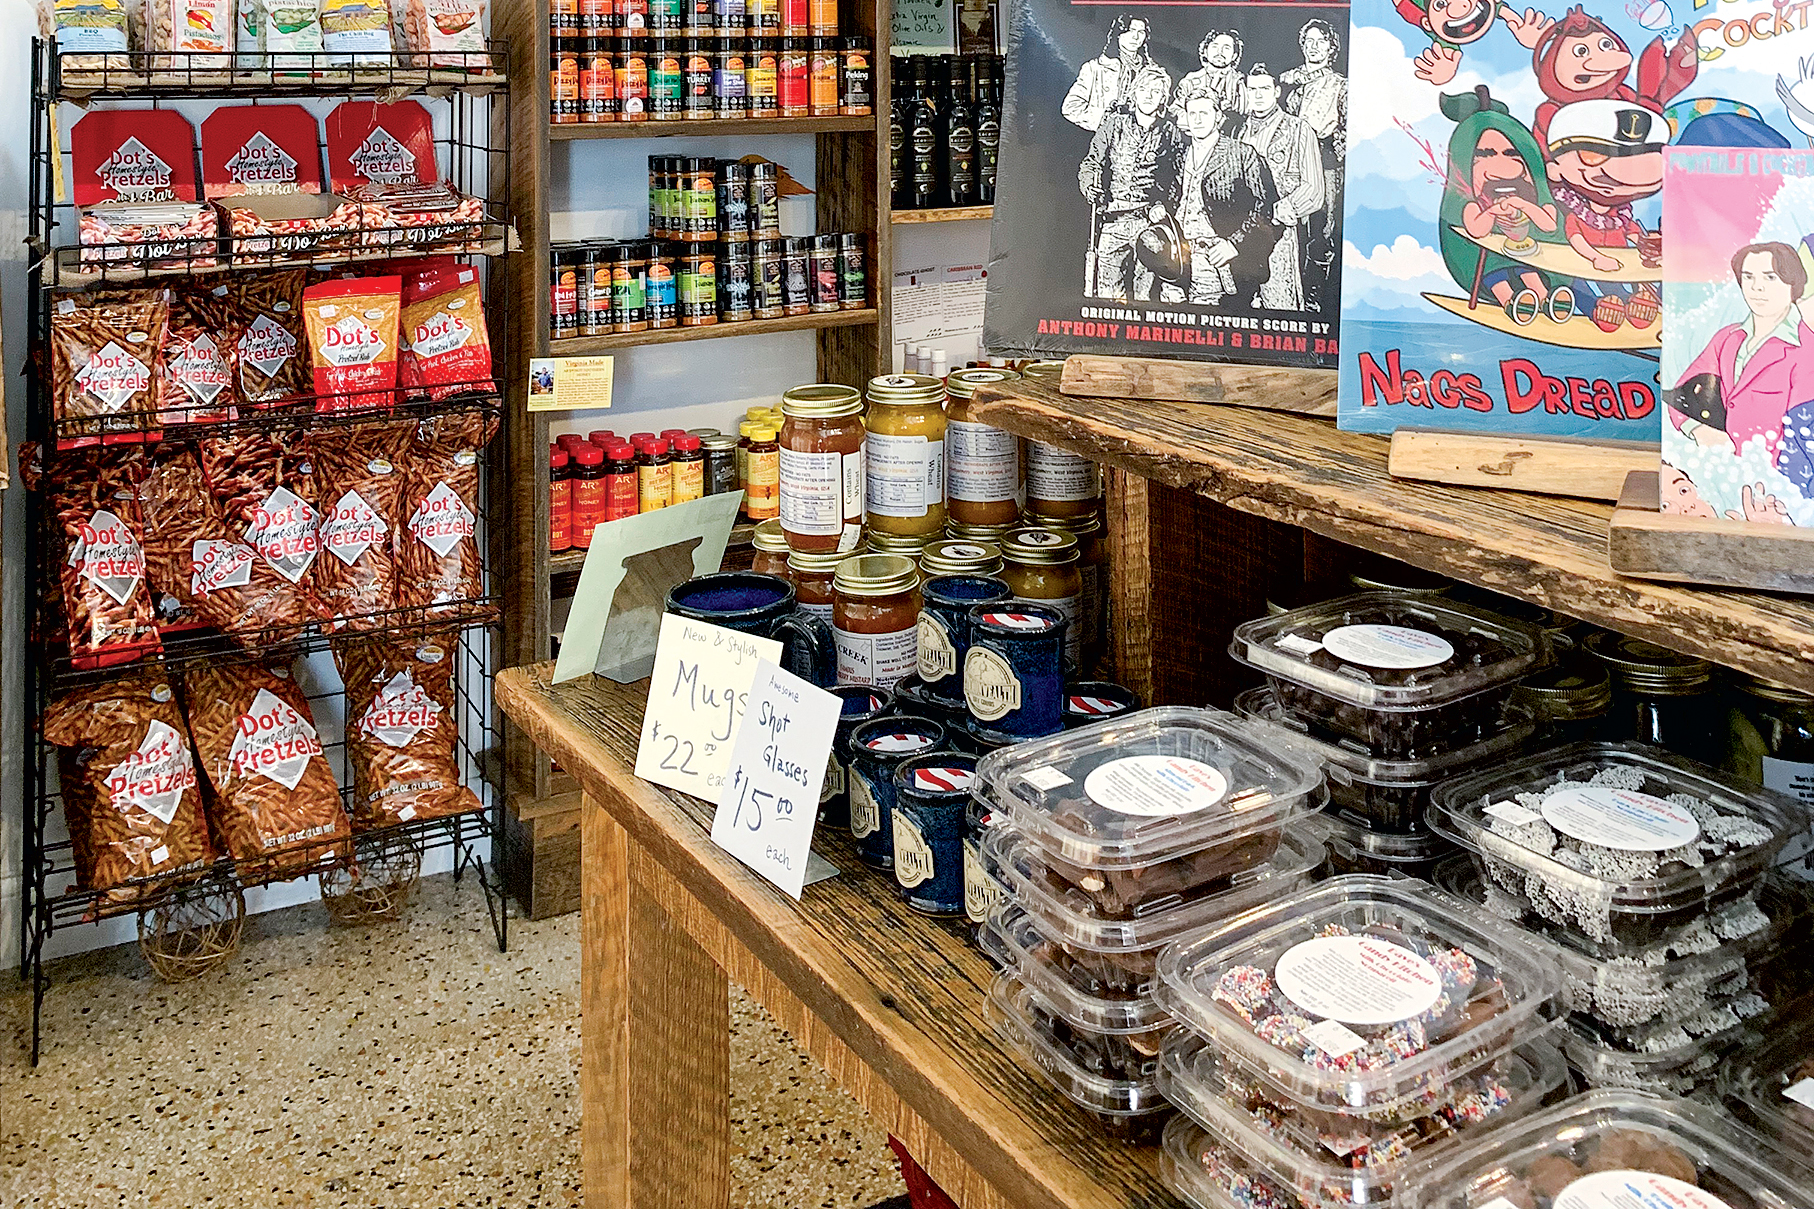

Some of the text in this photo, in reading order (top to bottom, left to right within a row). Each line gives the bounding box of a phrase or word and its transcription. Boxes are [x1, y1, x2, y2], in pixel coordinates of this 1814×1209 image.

[188, 0, 216, 8] Limón
[268, 0, 317, 8] pistachios
[910, 9, 939, 24] Virgin
[183, 29, 222, 40] Pistachios
[891, 23, 934, 33] Olive Oils
[686, 76, 712, 84] TURKEY
[845, 70, 869, 80] Peking
[239, 143, 281, 159] Dot's
[361, 137, 400, 153] Dot's
[111, 149, 155, 165] Dot's
[237, 156, 283, 169] Homestyle
[359, 151, 402, 163] Homestyle
[109, 164, 157, 175] Homestyle
[230, 165, 295, 181] Pretzels
[354, 159, 413, 177] Pretzels
[101, 171, 169, 188] Pretzels
[894, 269, 920, 278] CHOCOLATE
[946, 265, 973, 273] CARIBBEAN
[415, 314, 464, 343] Dot's
[1081, 306, 1330, 335] ORIGINAL MOTION PICTURE SCORE BY
[245, 322, 284, 340] Dot's
[326, 324, 380, 348] Dot's
[1037, 318, 1121, 340] ANTHONY
[1125, 325, 1225, 347] MARINELLI
[1231, 332, 1243, 347] &
[1249, 333, 1308, 353] BRIAN
[238, 344, 296, 363] Pretzels
[339, 343, 369, 354] Homestyle
[428, 345, 449, 355] Pretzel
[90, 352, 136, 368] Dot's
[337, 352, 371, 364] Pretzel Rub
[565, 360, 588, 368] Virginia
[80, 373, 149, 393] Pretzels
[328, 503, 373, 522] Dot's
[418, 493, 462, 516] Dot's
[252, 499, 313, 531] Dot's
[417, 510, 466, 526] Homestyle
[78, 522, 132, 546] Dot's
[255, 520, 317, 547] Homestyle
[411, 518, 474, 543] Pretzels
[191, 539, 232, 576] Dot's
[683, 626, 758, 666] New & Stylish
[837, 644, 869, 666] CREEK
[768, 674, 800, 704] Awesome
[672, 659, 749, 742] Mugs
[239, 702, 298, 739] Dot's
[758, 699, 791, 742] Shot
[233, 731, 321, 776] Pretzels
[762, 744, 810, 788] Glasses
[263, 836, 275, 850] NET
[765, 843, 792, 872] each
[1358, 940, 1435, 986] Candy Kitchen
